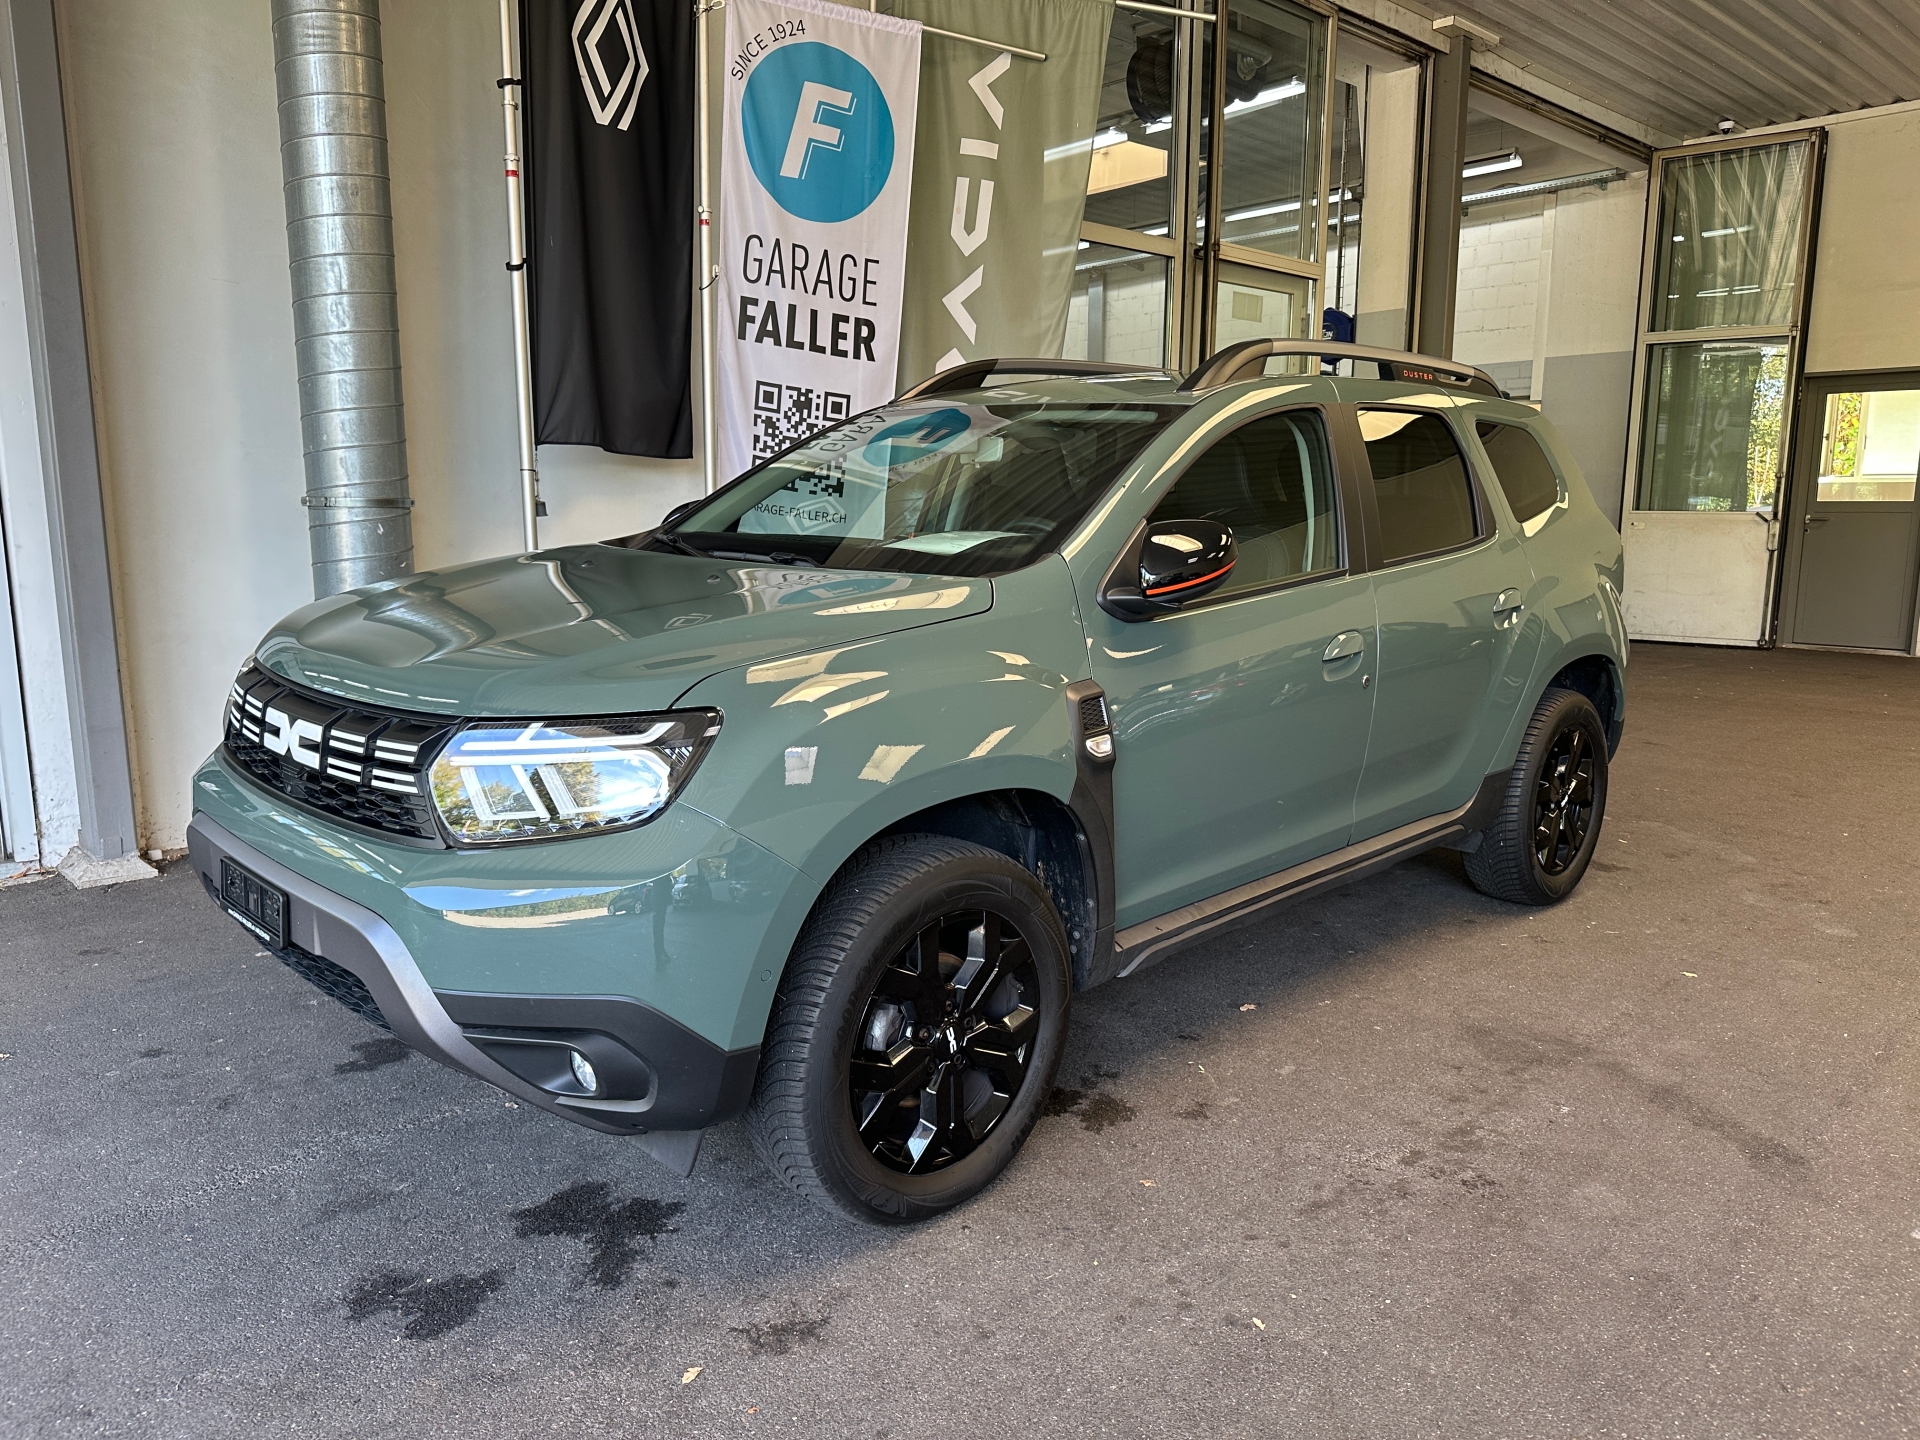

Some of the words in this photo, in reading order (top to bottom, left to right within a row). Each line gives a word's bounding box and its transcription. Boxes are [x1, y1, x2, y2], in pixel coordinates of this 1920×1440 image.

[731, 33, 768, 80] SINCE
[768, 19, 806, 42] 1924
[780, 80, 857, 180] F
[743, 234, 880, 307] GARAGE
[738, 295, 876, 362] FALLER
[1403, 370, 1433, 380] DUSTER
[753, 502, 847, 524] RAGE-FALLER.CH
